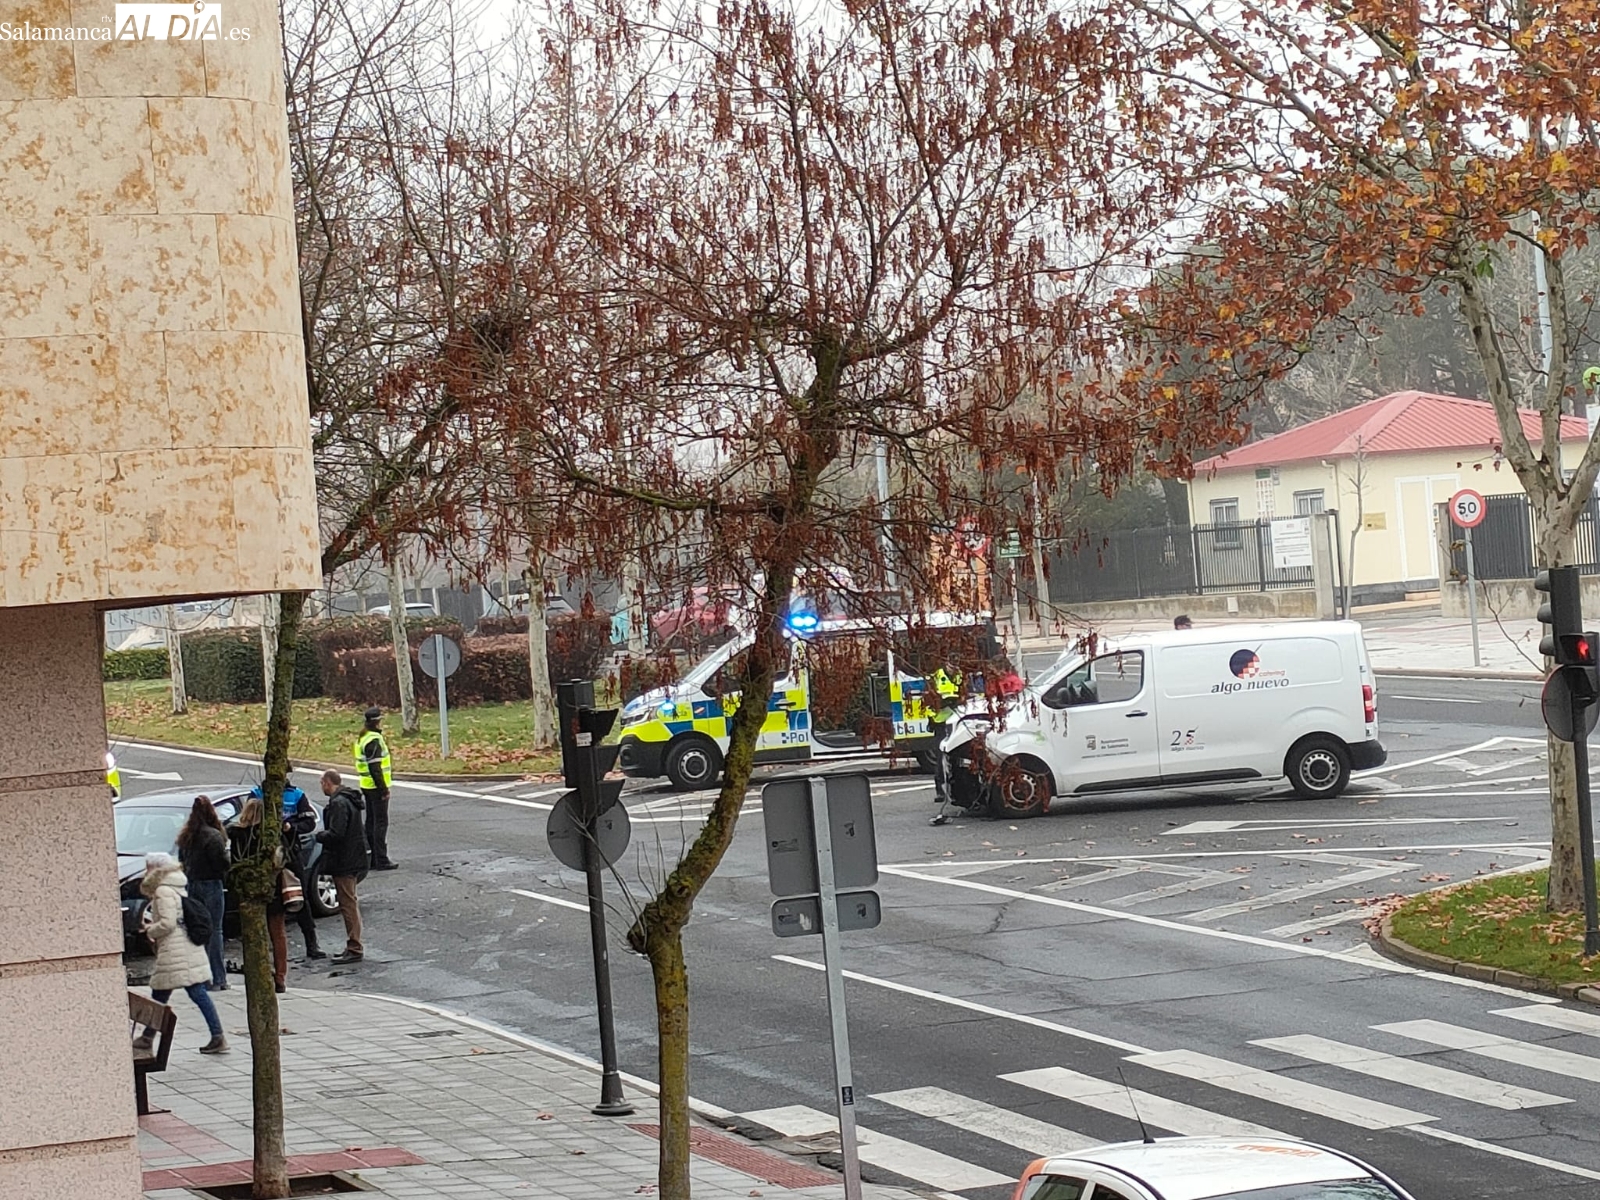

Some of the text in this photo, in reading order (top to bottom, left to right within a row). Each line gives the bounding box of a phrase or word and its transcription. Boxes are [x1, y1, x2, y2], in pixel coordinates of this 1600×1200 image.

[1457, 502, 1477, 515] 50
[1211, 678, 1290, 695] algo nuevo
